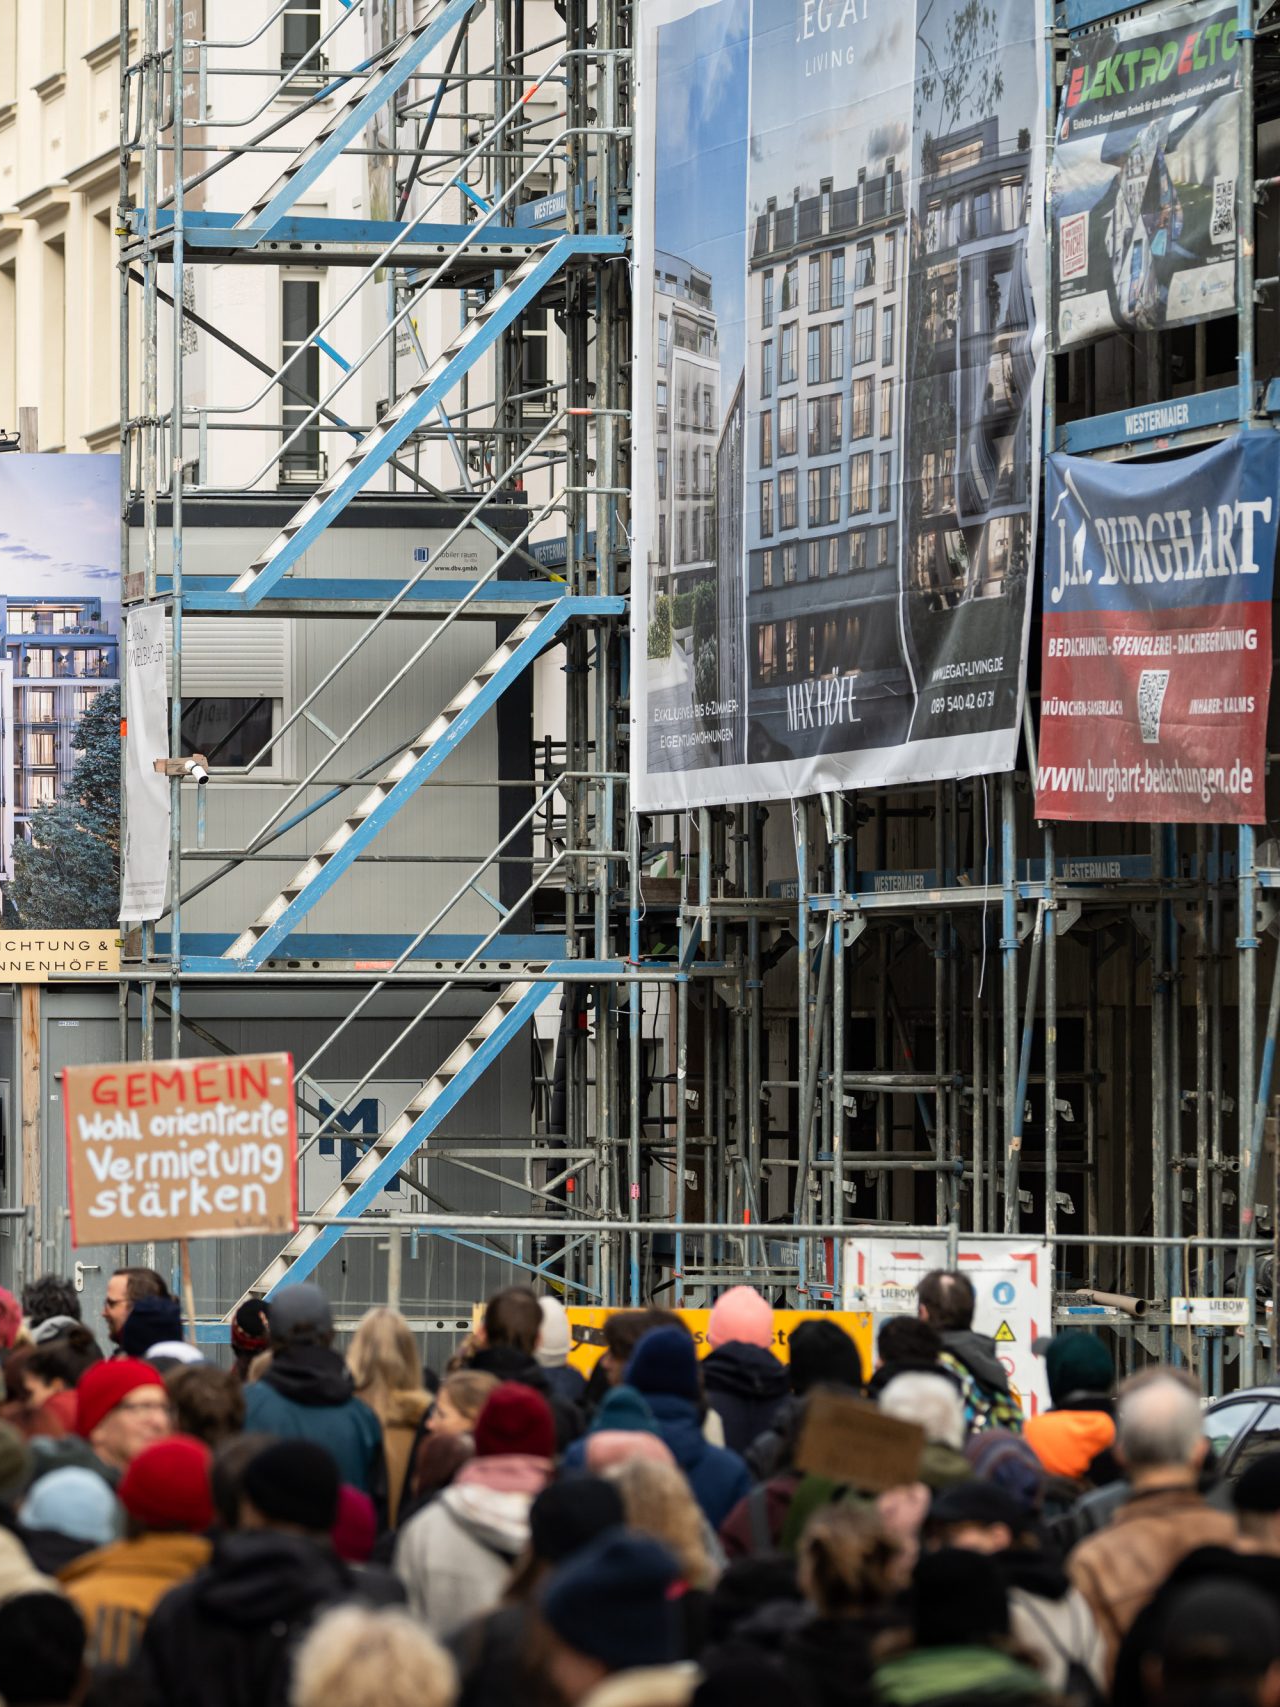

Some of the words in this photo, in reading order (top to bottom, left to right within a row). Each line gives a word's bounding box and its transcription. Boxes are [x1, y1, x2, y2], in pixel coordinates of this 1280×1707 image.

[796, 0, 868, 42] EGA
[805, 45, 855, 77] LIVING
[1066, 41, 1179, 108] ELEKTRO
[1072, 117, 1094, 130] Elektro-
[1098, 112, 1113, 124] Smart
[1125, 403, 1189, 436] WESTERMAIER
[1095, 497, 1273, 586] BURGHART
[786, 681, 815, 732] MAX
[817, 666, 862, 727] HÖFE
[930, 697, 945, 714] 089
[947, 695, 964, 712] 540
[965, 693, 975, 709] 42
[976, 691, 987, 708] 67
[1223, 696, 1255, 713] KALMS
[1035, 758, 1253, 803] www.burghart-bedachungen.de
[874, 874, 924, 892] WESTERMAIER
[98, 941, 108, 951] &
[77, 1110, 143, 1141] Wohl
[149, 1101, 289, 1139] orientierte
[86, 1139, 284, 1184] Vermietung
[88, 1178, 267, 1218] stärken
